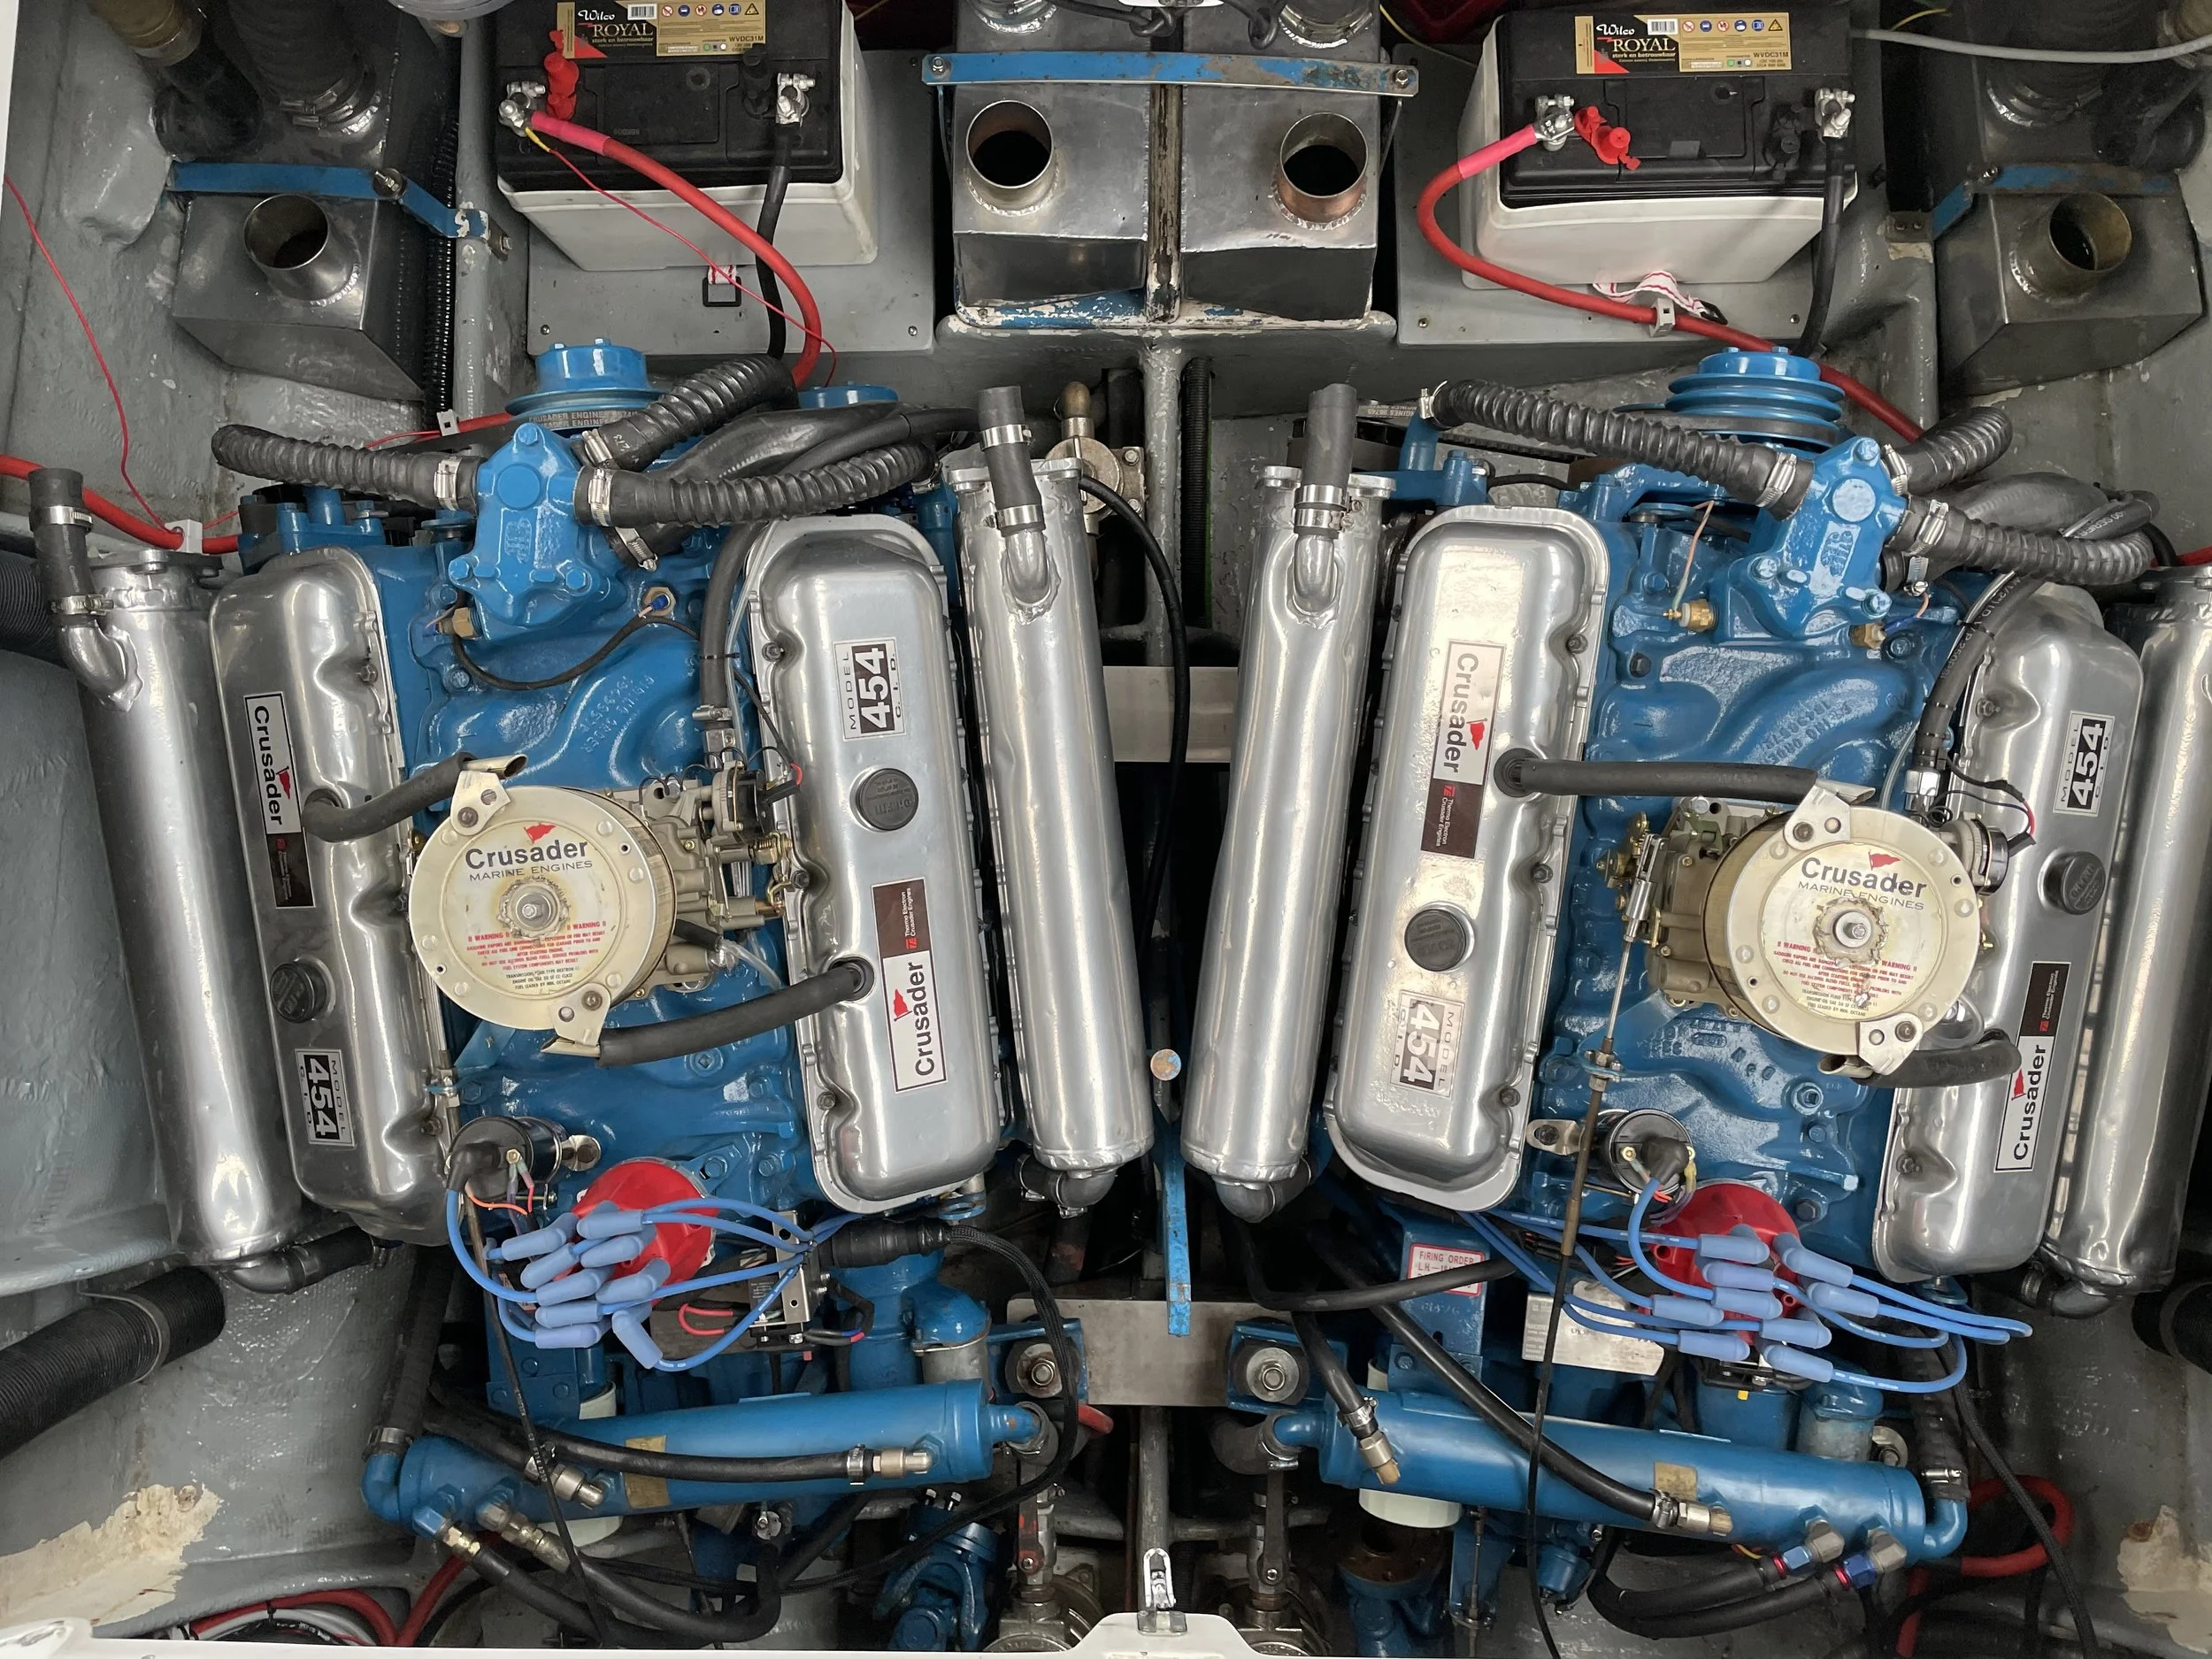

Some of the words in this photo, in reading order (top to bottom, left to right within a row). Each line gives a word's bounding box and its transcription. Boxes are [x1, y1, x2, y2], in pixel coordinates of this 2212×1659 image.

[577, 10, 616, 21] Wilco
[593, 22, 654, 37] ROYAL
[1596, 24, 1635, 35] Wilco
[1611, 38, 1676, 52] ROYAL
[842, 651, 856, 729] MODEL
[855, 648, 890, 729] 454
[1444, 653, 1479, 773] Crusader
[255, 706, 282, 826] Crusader
[2062, 723, 2079, 802] MODEL
[2072, 723, 2104, 805] 454
[465, 841, 588, 870] Crusader
[470, 867, 524, 881] MARINE
[531, 860, 593, 874] ENGINES
[1798, 881, 1852, 898] MARINE
[1858, 892, 1924, 910] ENGINES
[1801, 857, 1927, 898] Crusader
[474, 932, 503, 941] WARNING
[572, 920, 600, 930] WARNING
[1783, 941, 1811, 952] WARNING
[1881, 960, 1911, 971] WARNING
[908, 963, 935, 1076] Crusader
[1403, 1003, 1440, 1083] 454
[1439, 1012, 1455, 1087] MODEL
[308, 1058, 338, 1136] 454
[332, 1060, 345, 1134] MODEL
[2014, 1045, 2046, 1161] Crusader
[1419, 1251, 1444, 1262] FIRING
[1448, 1255, 1474, 1264] ORDER
